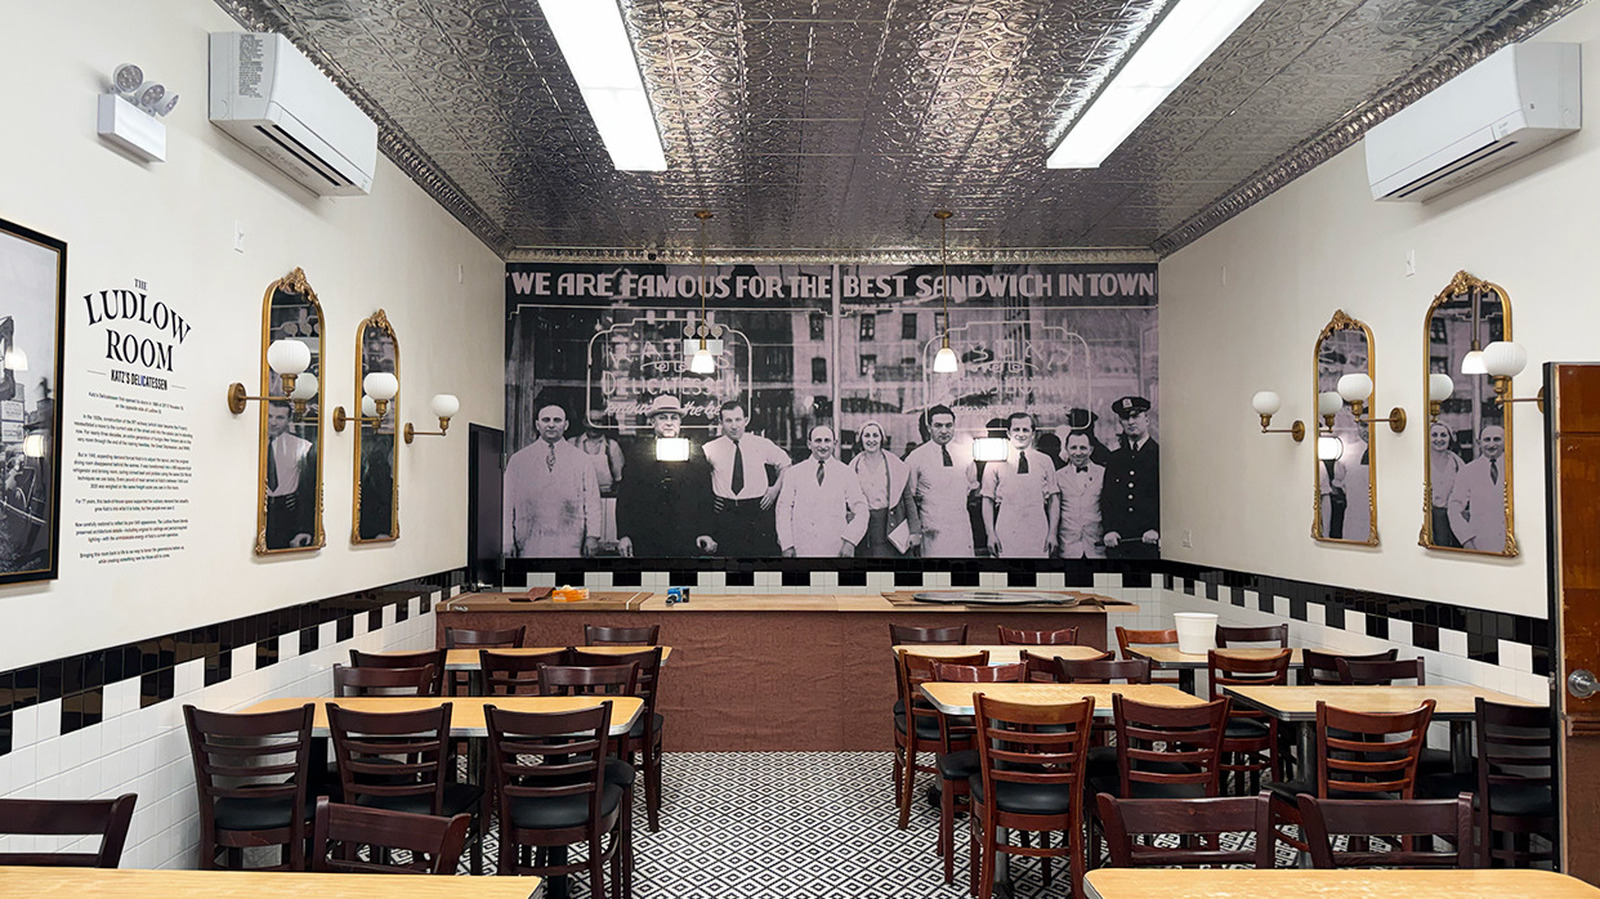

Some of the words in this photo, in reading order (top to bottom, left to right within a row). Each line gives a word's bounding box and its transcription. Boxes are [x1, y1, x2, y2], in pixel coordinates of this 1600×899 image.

[134, 278, 148, 291] THE
[557, 273, 613, 296] ARE
[621, 274, 730, 298] FAMOUS
[736, 276, 784, 298] FOR
[789, 276, 831, 298] THE
[843, 275, 908, 298] BEST
[915, 274, 1052, 298] SANDWICH
[1059, 274, 1084, 296] IN
[1086, 272, 1154, 297] TOWN
[84, 290, 191, 344] LUDLOW
[106, 329, 173, 371] ROOM
[111, 370, 130, 384] KATZ'S
[131, 373, 167, 390] DELICATESSEN
[602, 370, 741, 398] DELICATESSEN
